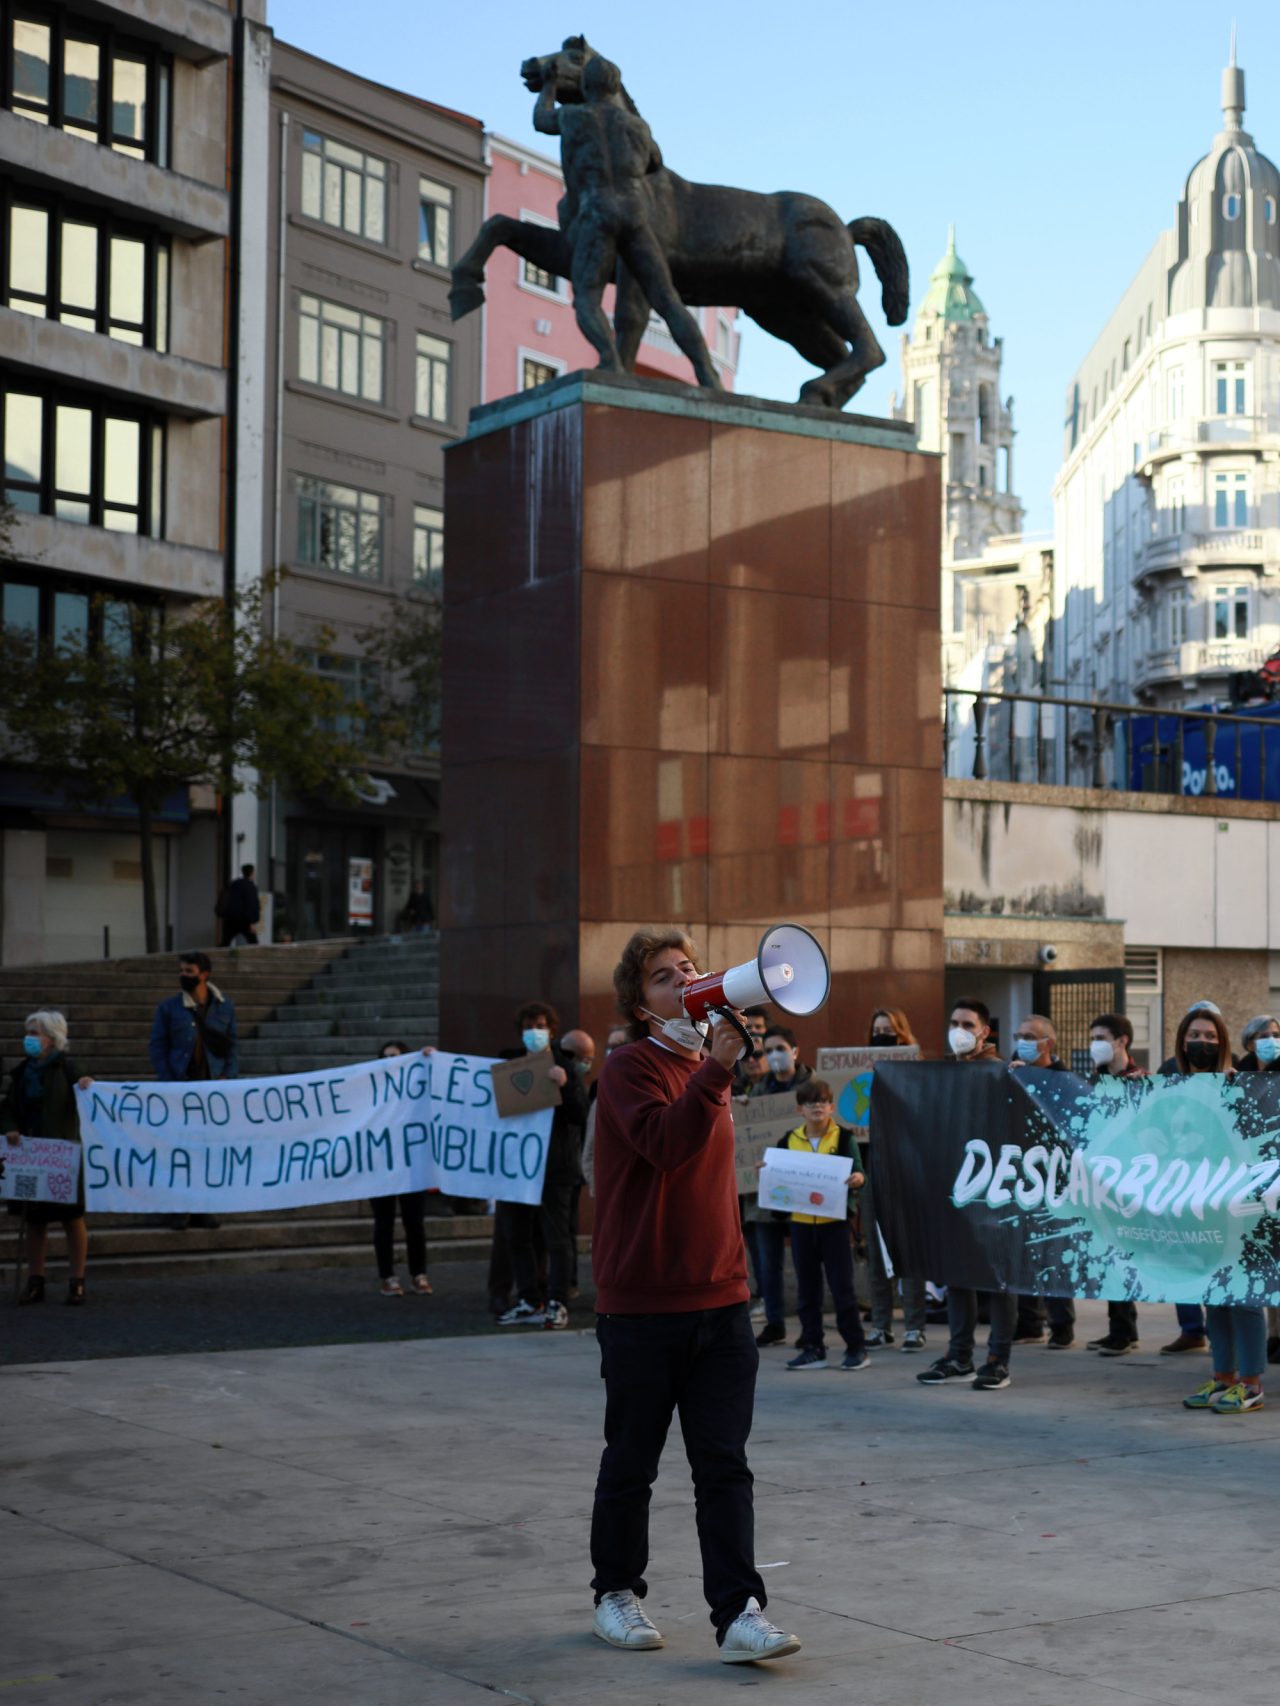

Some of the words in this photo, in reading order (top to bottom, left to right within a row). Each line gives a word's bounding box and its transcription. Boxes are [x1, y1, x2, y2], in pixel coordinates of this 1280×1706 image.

[91, 1085, 168, 1126] NÃO
[183, 1091, 230, 1125] AO
[243, 1078, 350, 1124] CORTE
[370, 1057, 492, 1107] INGLÊS
[88, 1145, 156, 1189] SIM
[169, 1148, 191, 1188] A
[205, 1146, 252, 1188] UM
[262, 1126, 393, 1187] JARDIM
[403, 1113, 543, 1181] PÚBLICO
